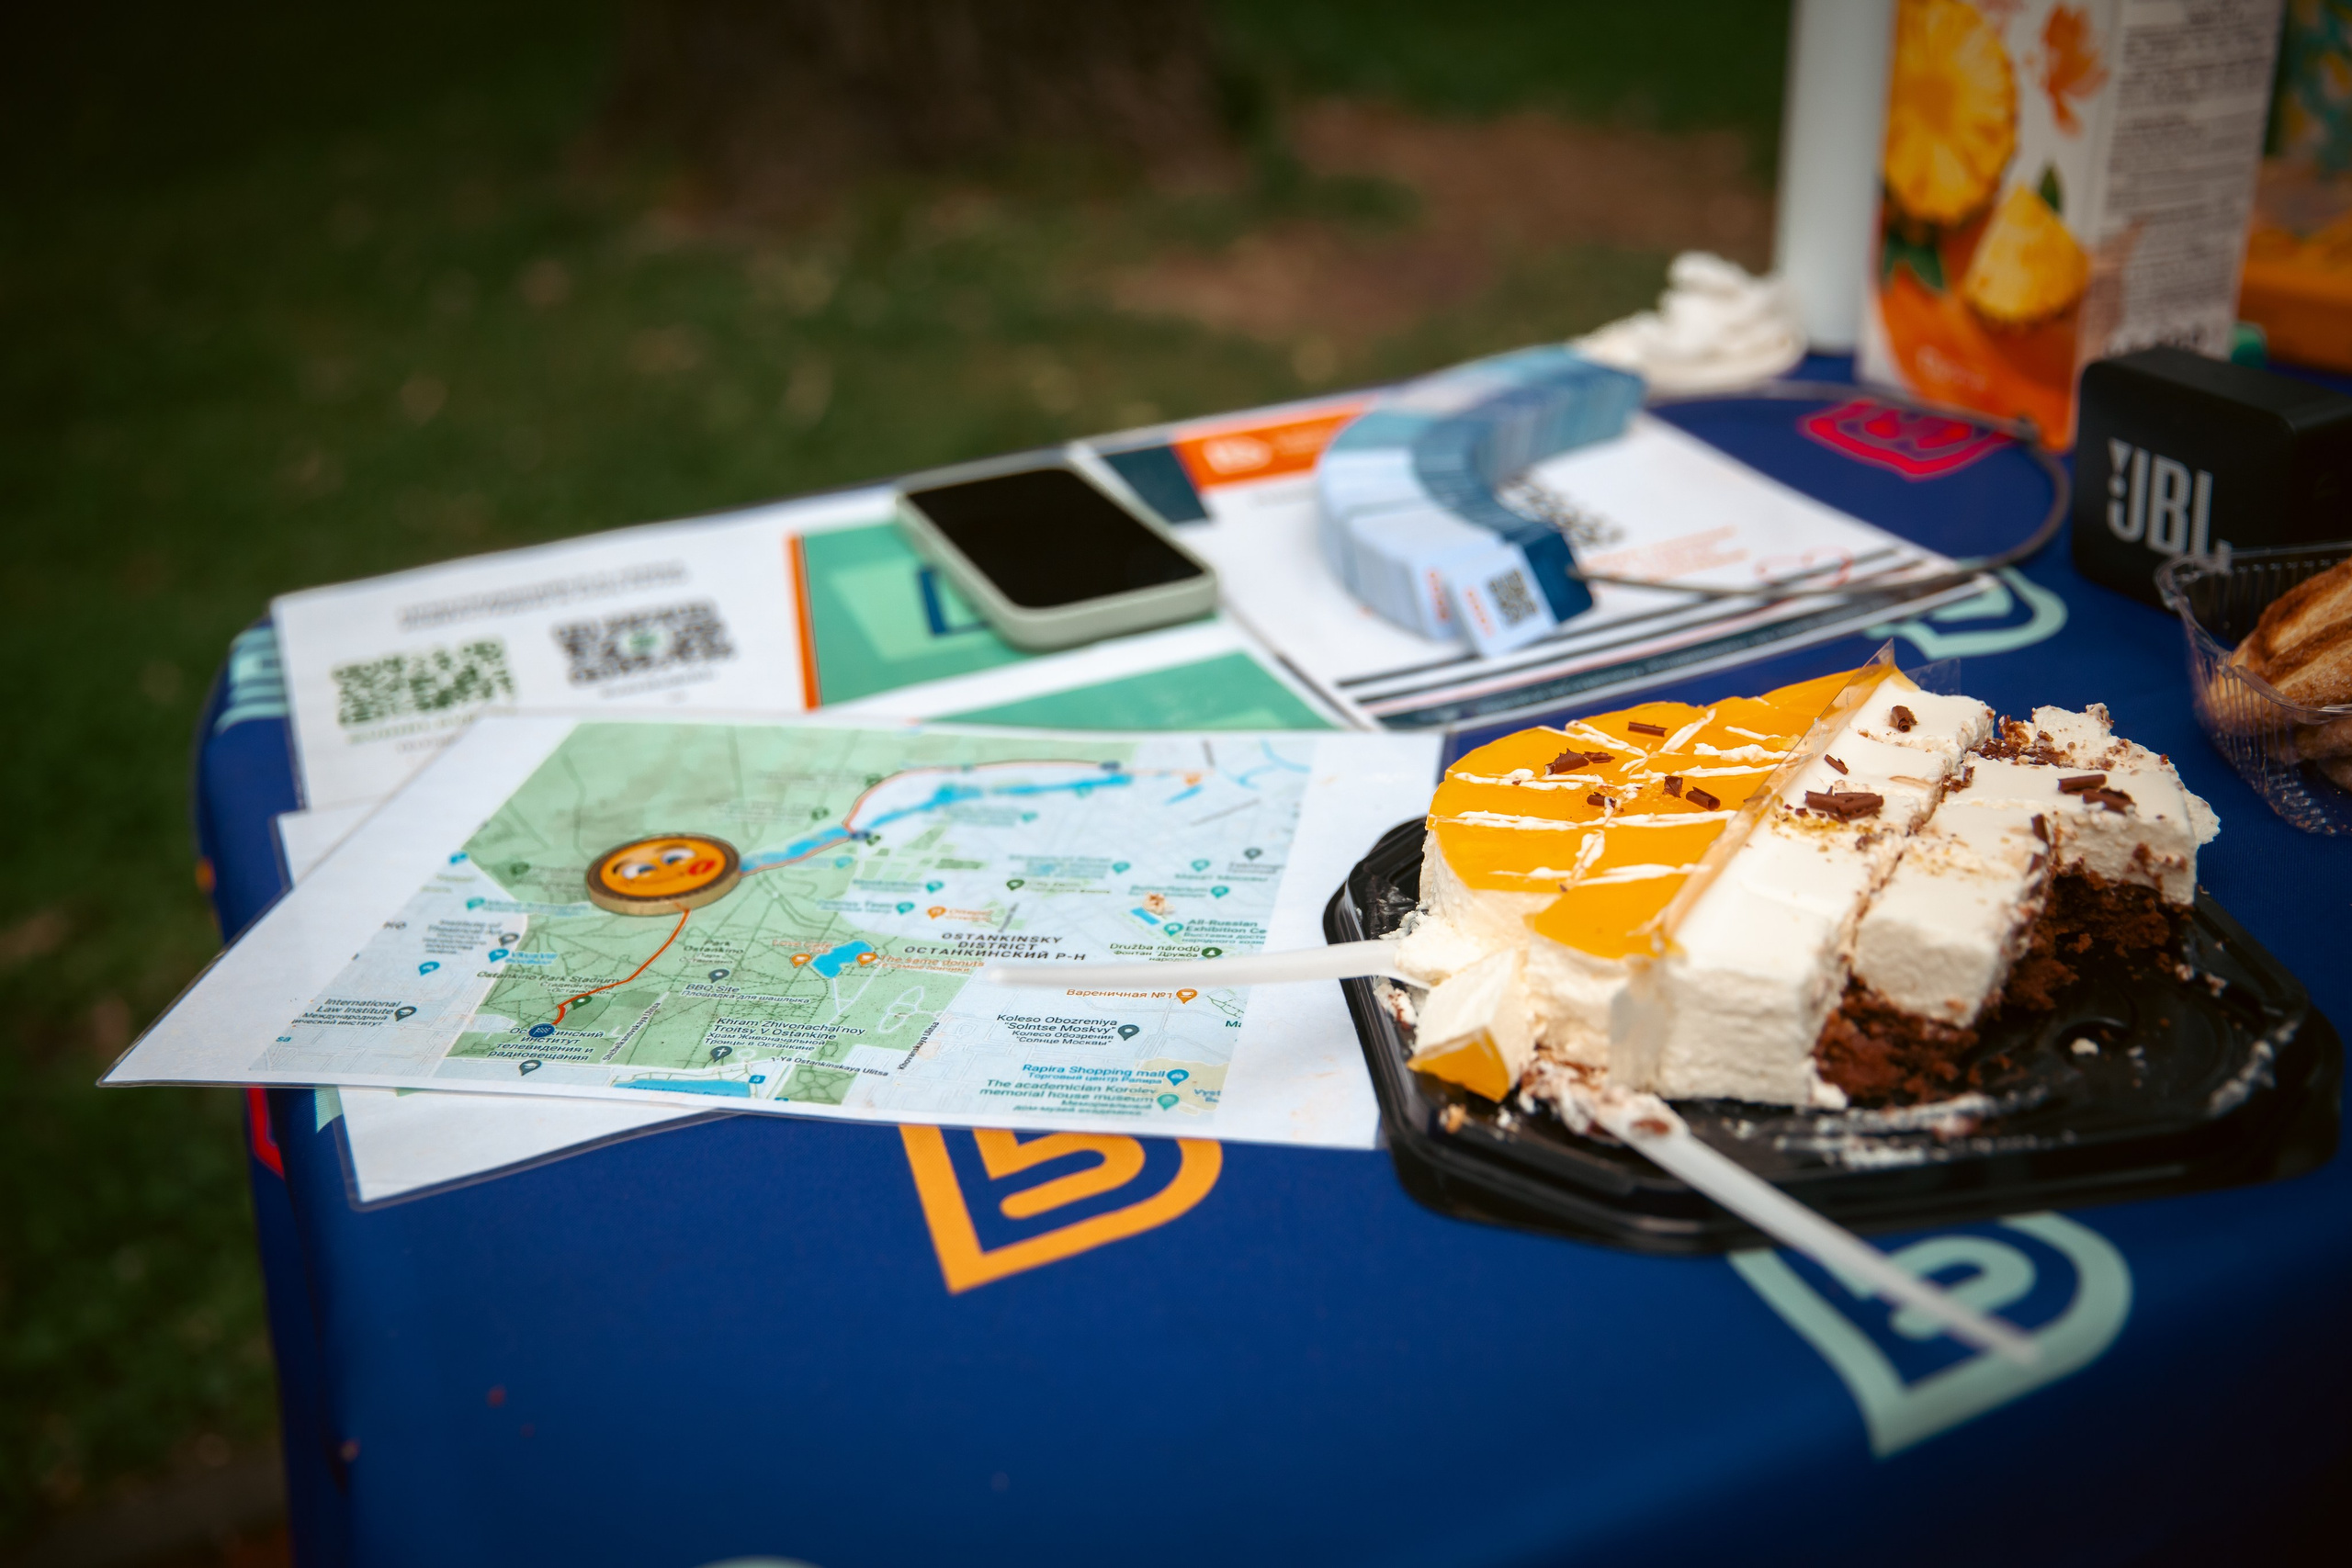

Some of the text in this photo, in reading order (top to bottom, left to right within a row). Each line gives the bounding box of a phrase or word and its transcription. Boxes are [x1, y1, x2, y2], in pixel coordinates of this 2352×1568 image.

[941, 932, 1063, 944] OSTANKINSKY
[957, 941, 1038, 951] DISTRICT
[904, 946, 1087, 961] ОСТАНКИНСКИЙ Р-Н
[906, 956, 939, 964] same
[941, 958, 985, 967] donuts
[476, 971, 620, 984] Ostankino Park Stadium
[685, 984, 741, 993] BBQ Site
[1066, 988, 1148, 998] Вареничная
[324, 998, 401, 1008] International
[315, 1005, 394, 1015] Law Institute
[997, 1014, 1118, 1027] Koleso Obozreniya
[716, 1017, 866, 1036] Khram Zhivonachal'noy
[509, 1027, 604, 1038] Осинский
[713, 1024, 757, 1035] Troitsy
[773, 1028, 837, 1041] Ostankine
[1012, 1030, 1114, 1040] Колесо Обозрения
[521, 1036, 581, 1046] институт
[704, 1038, 745, 1047] Троицы
[756, 1041, 816, 1052] Останкине
[738, 1034, 826, 1046] Живоначальной
[496, 1043, 582, 1053] телевидения
[487, 1050, 589, 1061] радиовещания
[794, 1057, 861, 1073] Ostankinskaya
[862, 1067, 889, 1077] Ulitsa
[1023, 1064, 1166, 1078] Rapira Shopping mall
[1028, 1072, 1083, 1080] Торговый
[987, 1079, 1158, 1095] The academician Korolev
[979, 1088, 1154, 1103] memorial house museum
